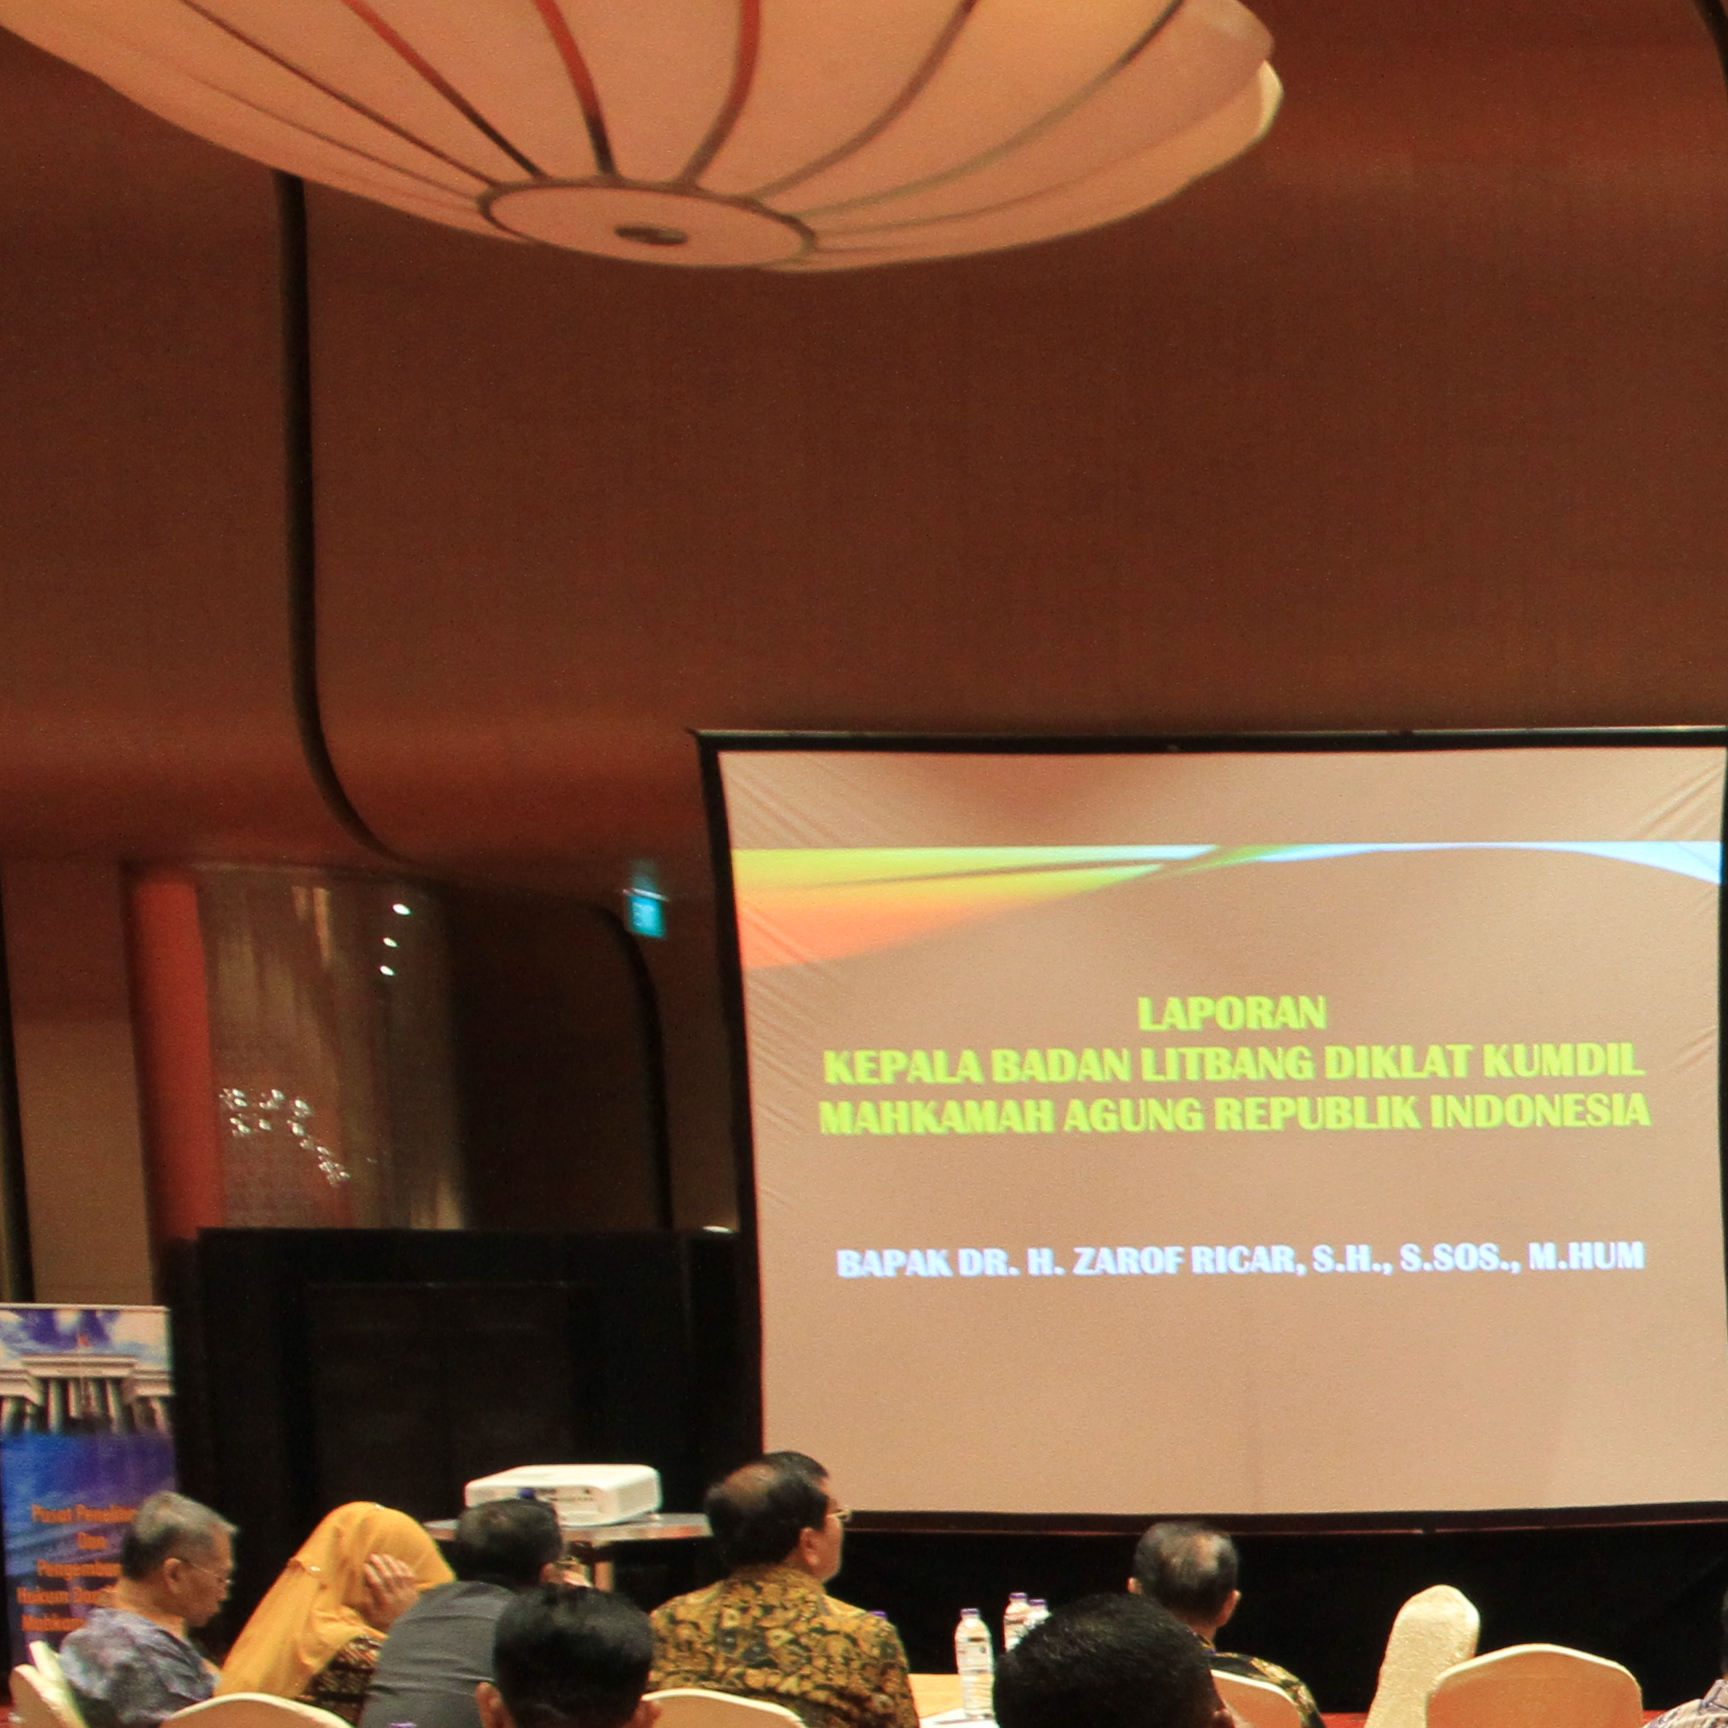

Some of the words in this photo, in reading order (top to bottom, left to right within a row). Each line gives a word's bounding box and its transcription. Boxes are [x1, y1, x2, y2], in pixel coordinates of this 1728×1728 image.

[1138, 994, 1329, 1032] LAPORAN
[823, 1047, 984, 1086] KEPALA
[991, 1046, 1132, 1084] BADAN
[1140, 1045, 1315, 1082] LITBANG
[1324, 1043, 1473, 1080] DIKLAT
[1481, 1042, 1646, 1079] KUMDIL
[818, 1099, 1056, 1136] MAHKAMAH
[1063, 1097, 1205, 1133] AGUNG
[1213, 1094, 1422, 1131] REPUBLIK
[1430, 1091, 1654, 1129] INDONESIA
[836, 1247, 954, 1280] BAPAK
[957, 1247, 1020, 1278] DR.
[1026, 1246, 1066, 1277] H.
[1072, 1245, 1185, 1276] ZAROF
[1190, 1244, 1307, 1277] RICAR,
[1311, 1243, 1393, 1276] S.H.,
[1399, 1242, 1521, 1275] S.SOS.,
[1528, 1240, 1646, 1273] M.HUM
